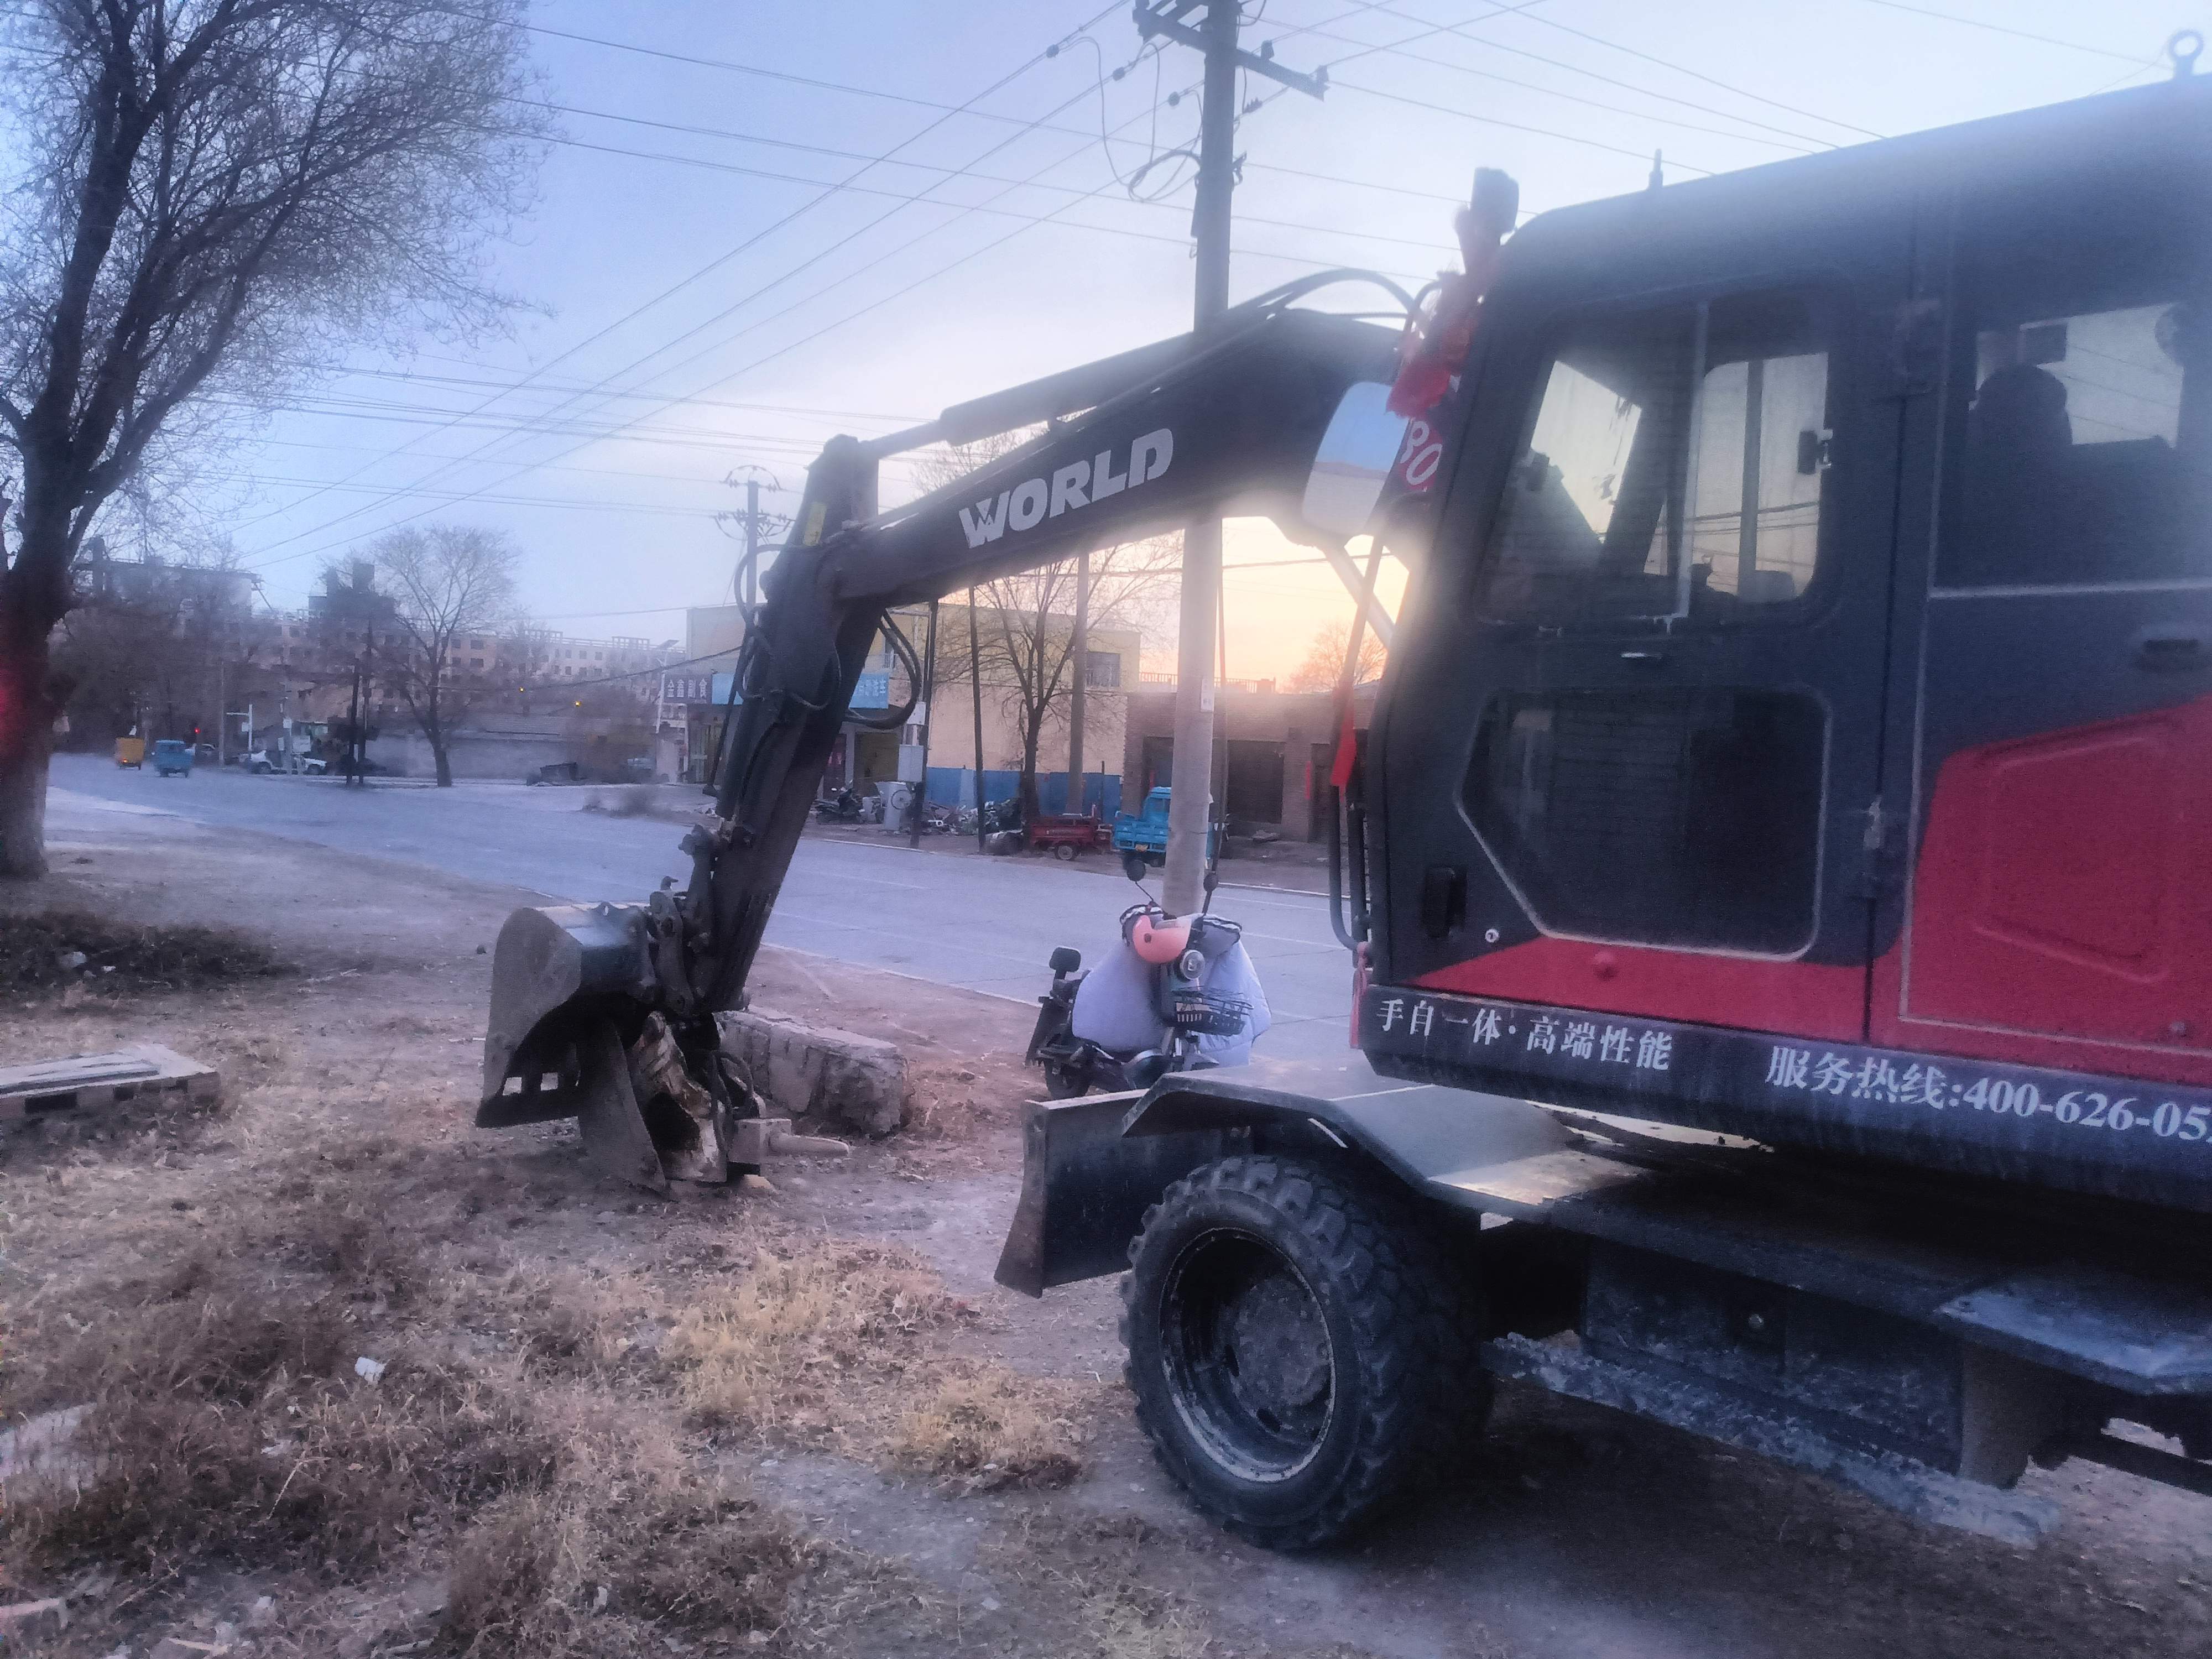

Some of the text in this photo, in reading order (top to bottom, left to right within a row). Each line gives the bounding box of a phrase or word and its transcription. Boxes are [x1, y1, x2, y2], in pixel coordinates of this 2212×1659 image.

[958, 428, 1173, 549] WORLD
[1764, 1045, 2212, 1144] 服务热线:400-626-05
